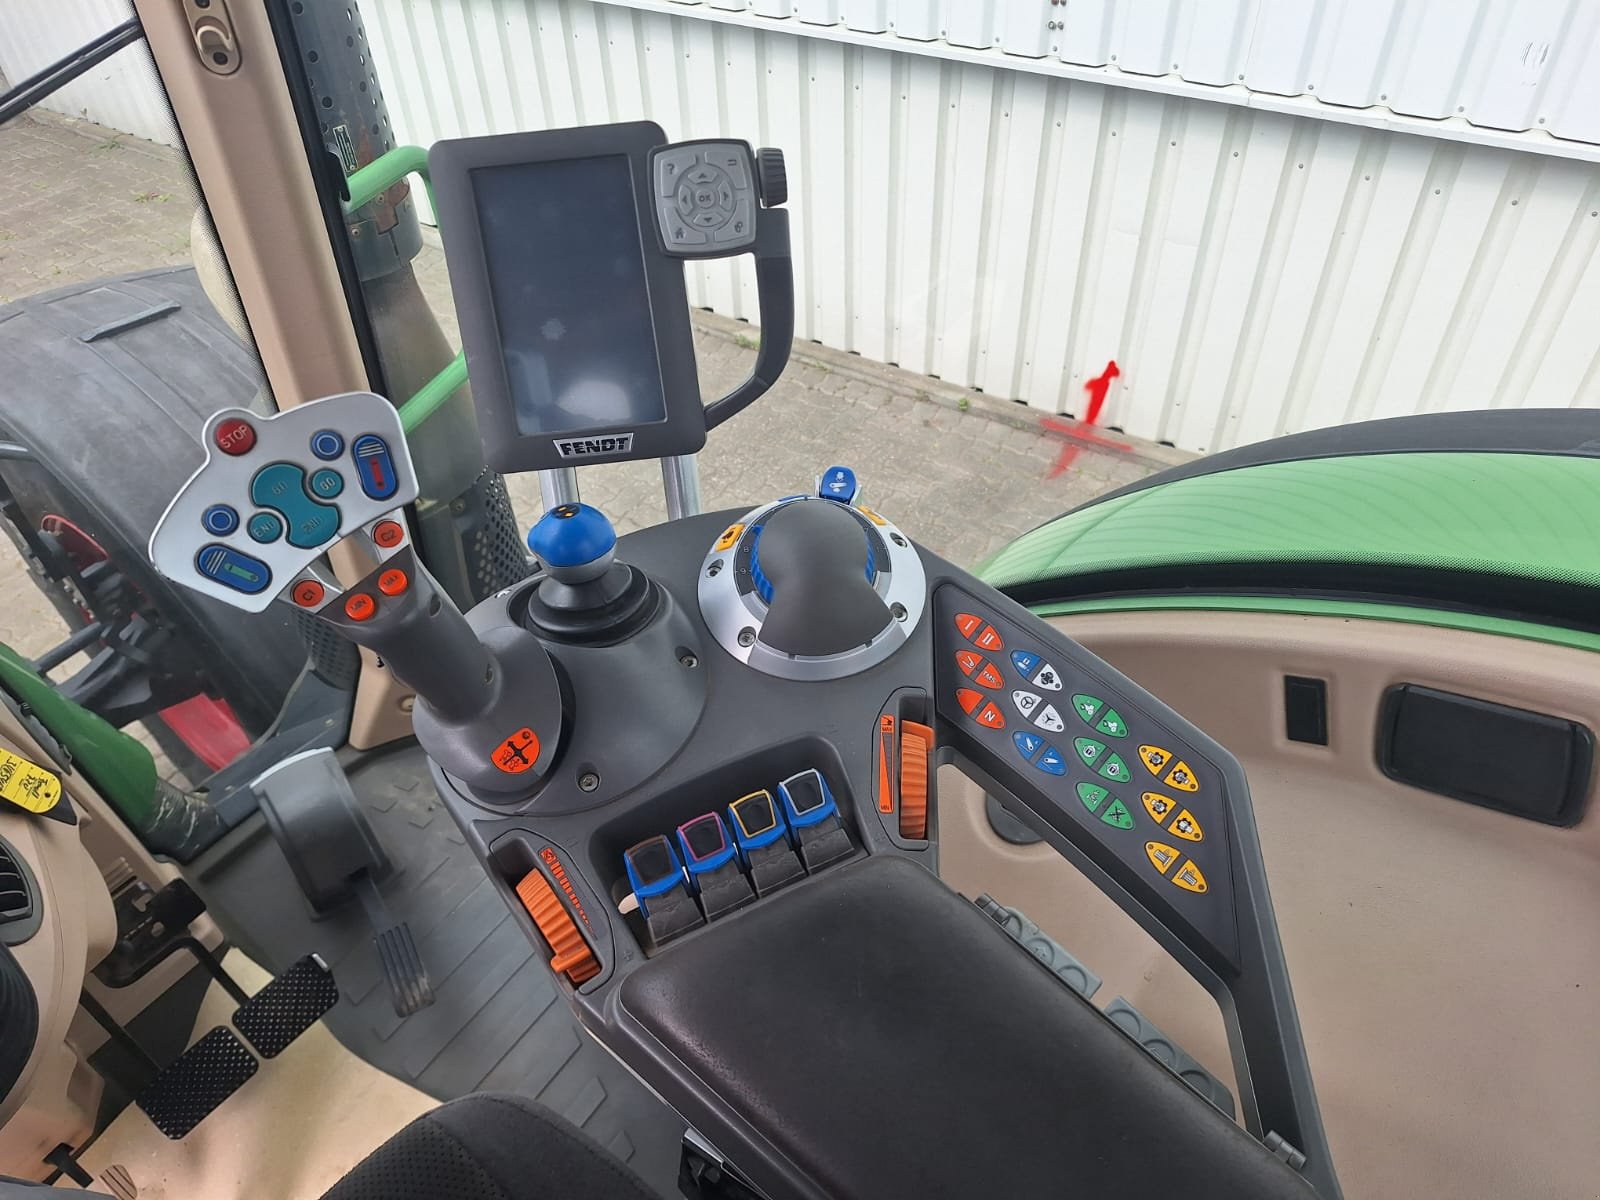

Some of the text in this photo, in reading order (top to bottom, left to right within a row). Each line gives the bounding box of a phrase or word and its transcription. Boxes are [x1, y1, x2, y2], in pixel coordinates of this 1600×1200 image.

[699, 194, 711, 202] OK
[220, 424, 248, 449] STOP
[560, 437, 629, 455] FENDT
[272, 481, 287, 494] GO
[320, 477, 336, 491] GO
[254, 521, 275, 537] END
[381, 529, 397, 542] C2
[740, 567, 747, 575] 9
[302, 589, 317, 602] C1
[983, 671, 996, 683] TMS
[984, 710, 996, 722] N
